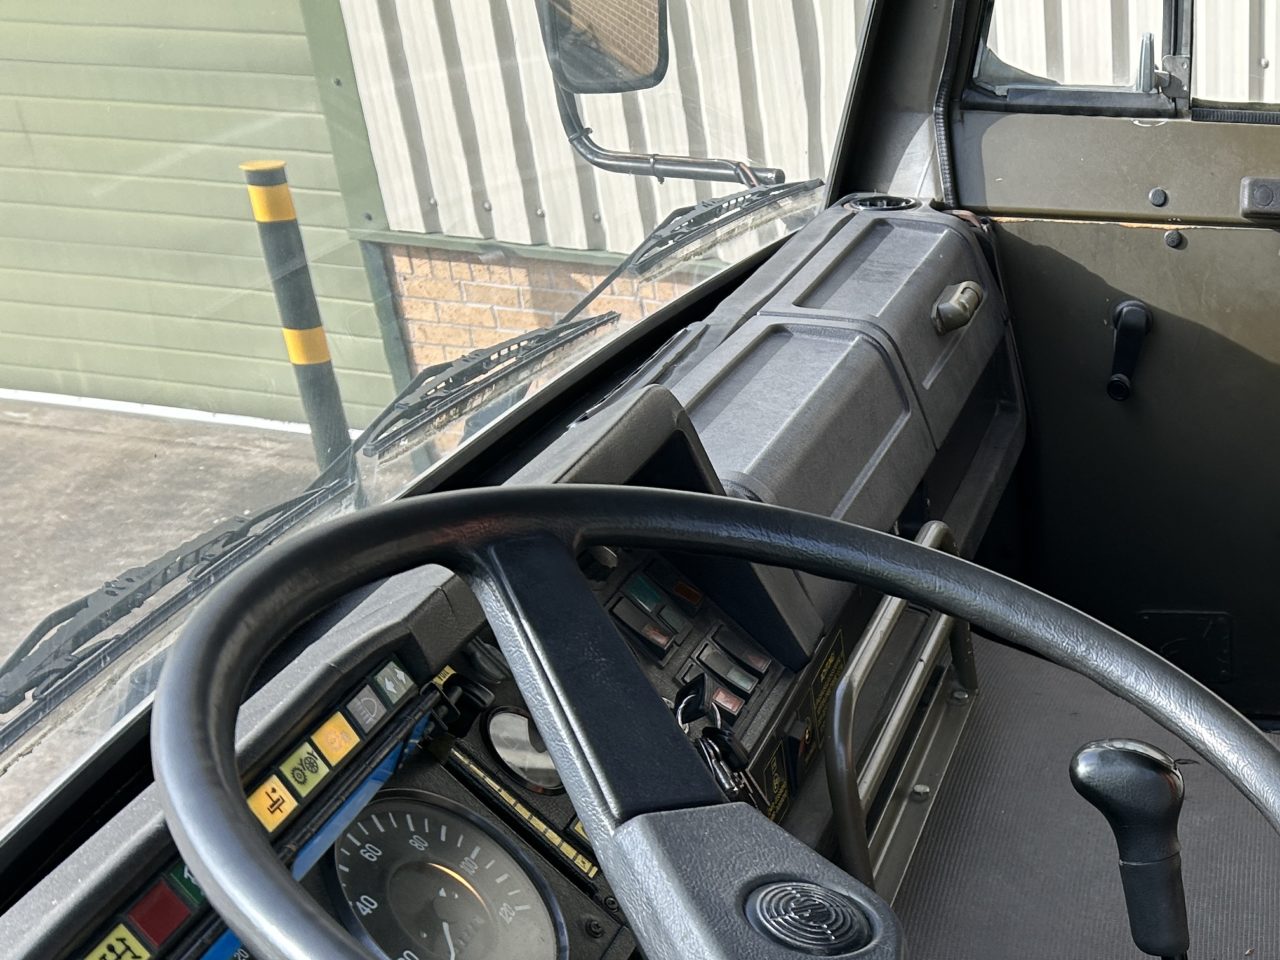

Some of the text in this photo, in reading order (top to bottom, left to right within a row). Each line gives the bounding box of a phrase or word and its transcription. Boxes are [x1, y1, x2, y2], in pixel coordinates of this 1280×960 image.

[409, 834, 429, 850] 80
[360, 844, 382, 862] 60
[460, 856, 480, 876] 100
[356, 895, 379, 916] 40
[500, 902, 516, 924] 120
